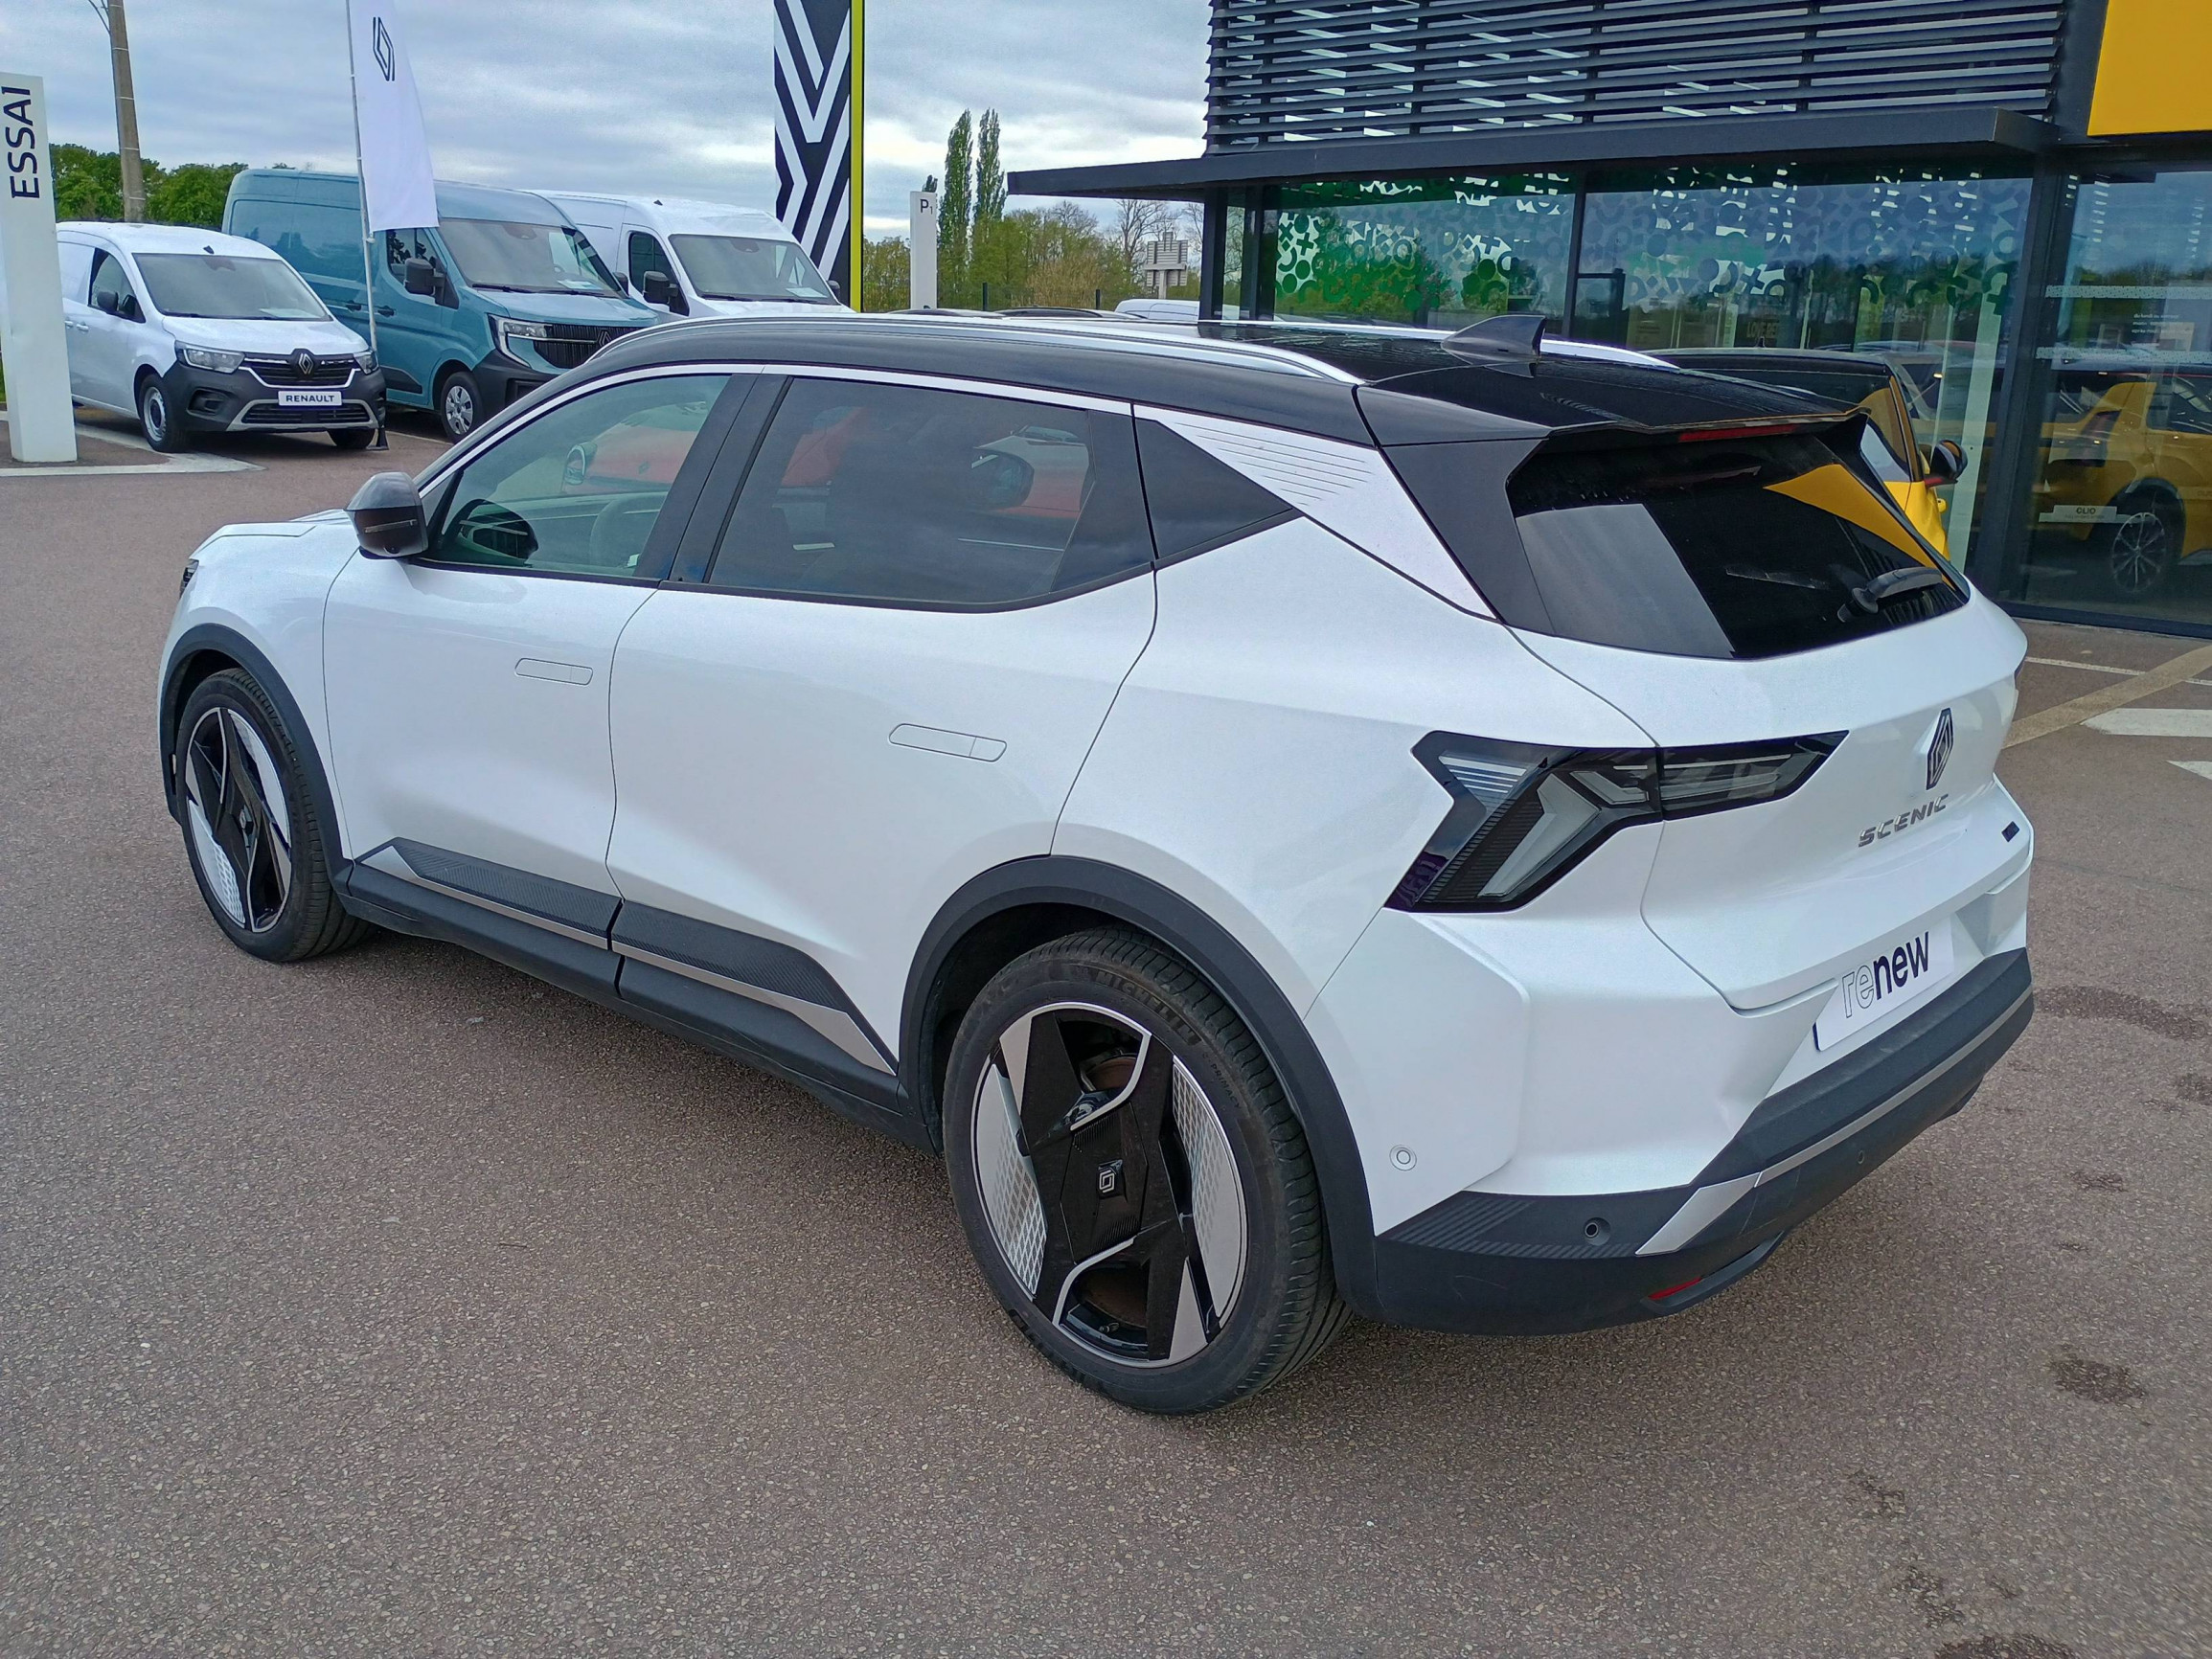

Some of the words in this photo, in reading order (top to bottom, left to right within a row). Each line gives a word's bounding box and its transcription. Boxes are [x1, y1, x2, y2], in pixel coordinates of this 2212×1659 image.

[1, 86, 40, 199] ESSAI
[1858, 794, 1949, 847] SCENIC
[1841, 931, 1929, 1019] renew
